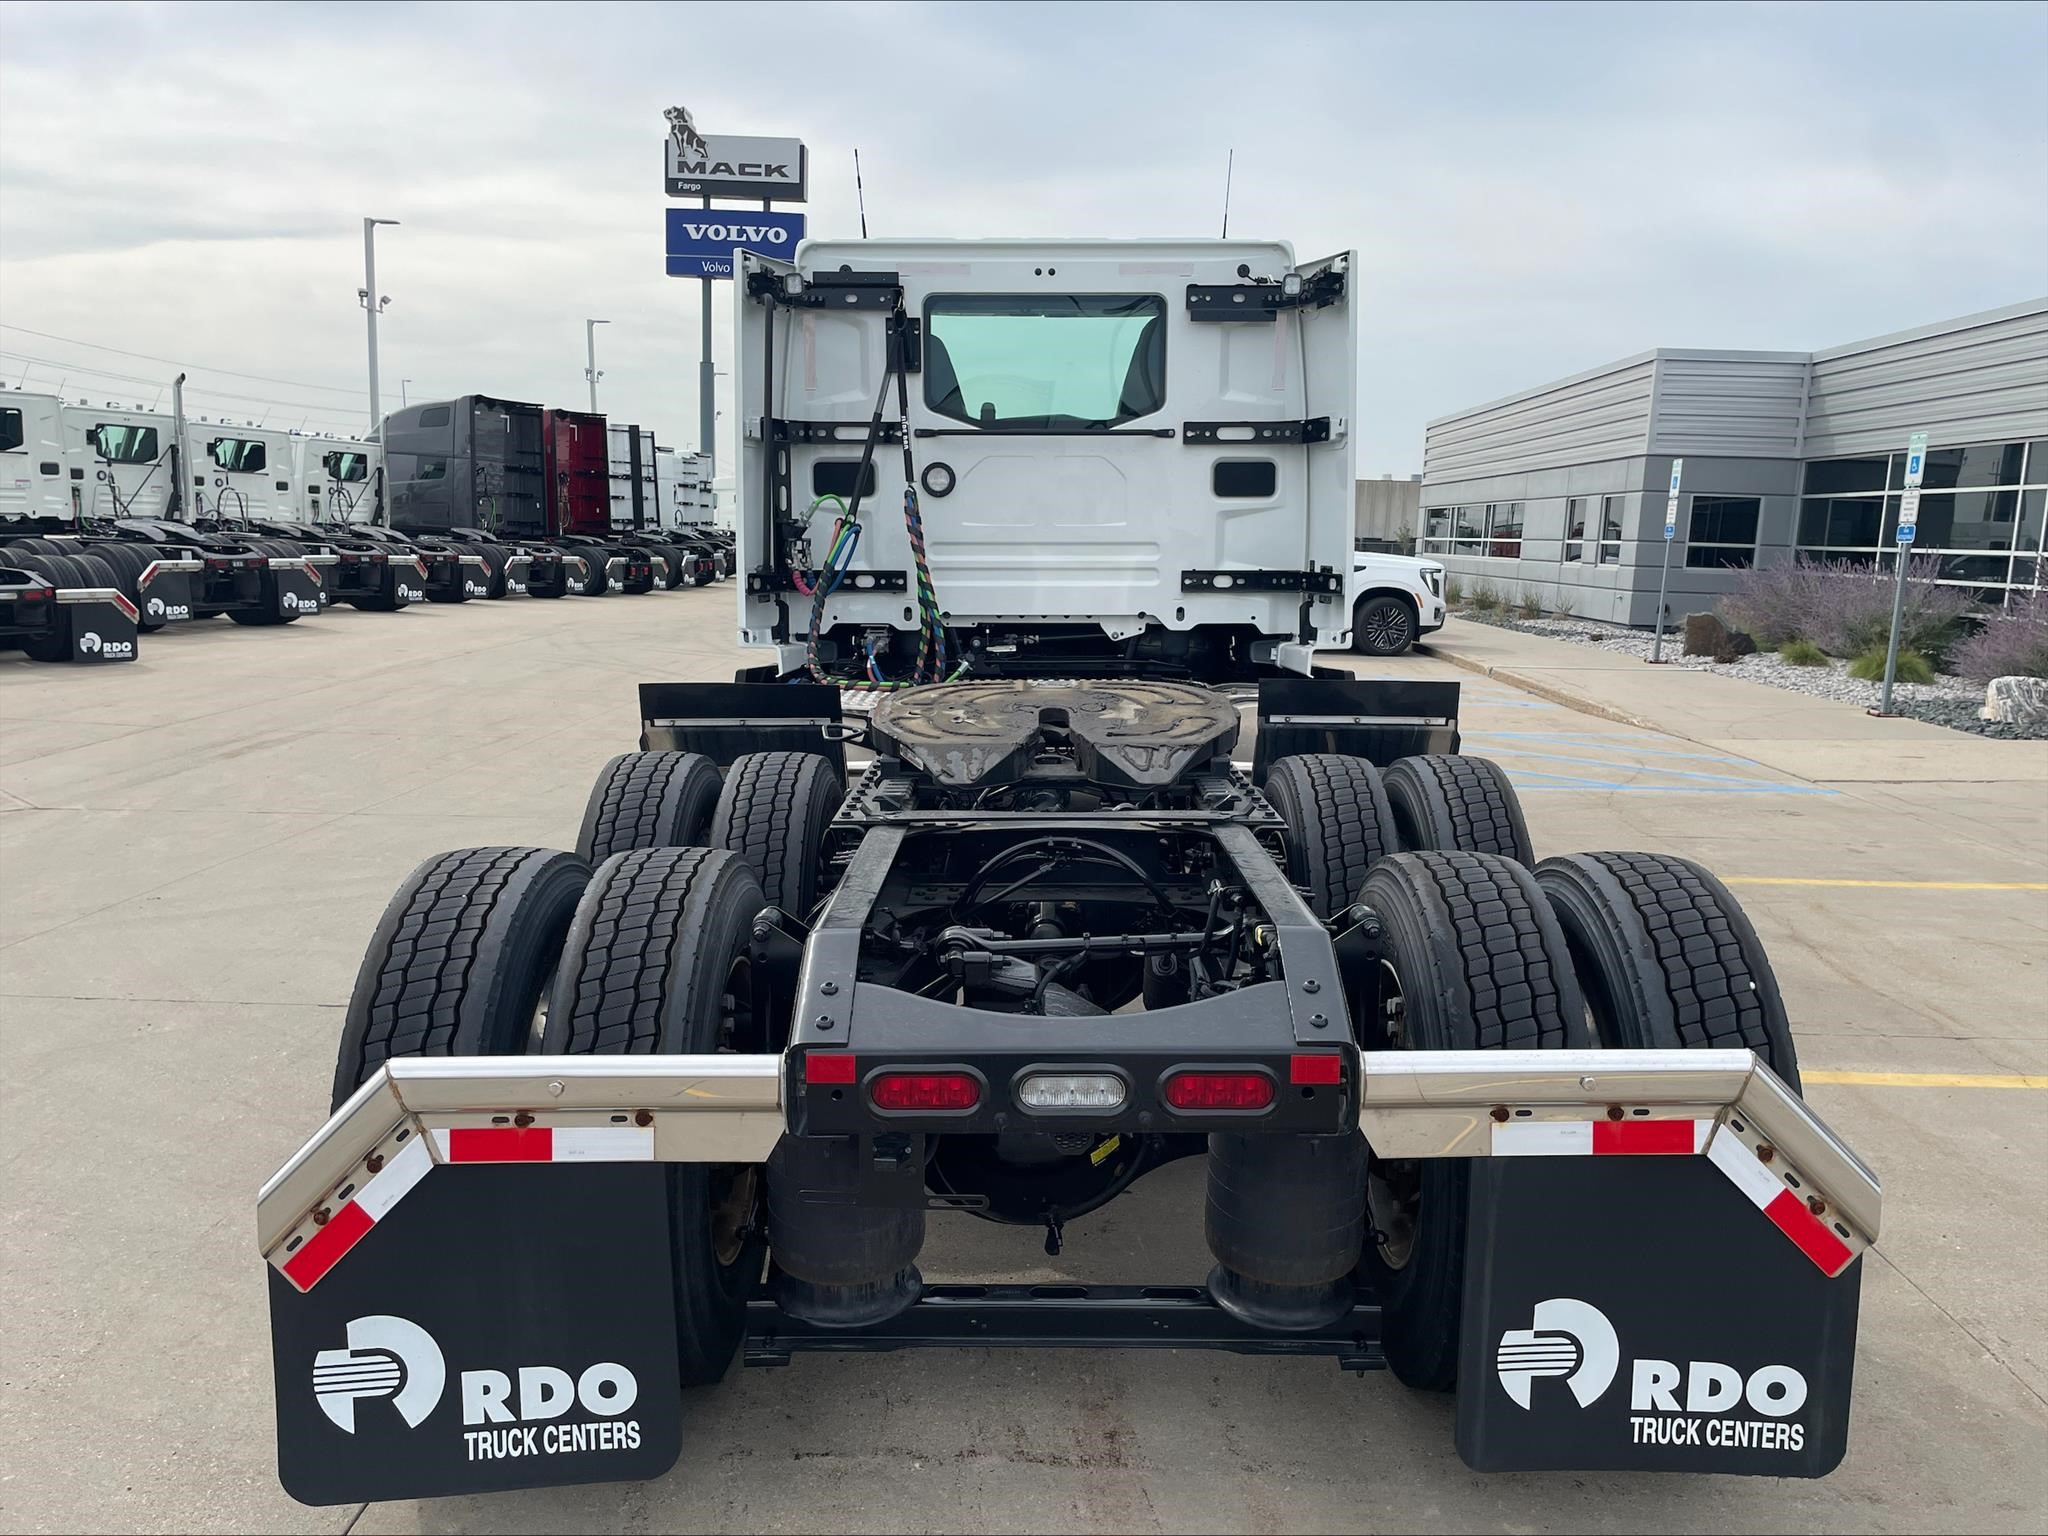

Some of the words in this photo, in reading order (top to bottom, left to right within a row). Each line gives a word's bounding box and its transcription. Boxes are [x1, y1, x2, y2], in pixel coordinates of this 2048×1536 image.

[677, 160, 789, 178] MACK
[677, 181, 701, 192] Fargo
[682, 223, 788, 244] VOLVO
[701, 260, 731, 273] Volvo
[166, 605, 188, 615] RDO
[298, 600, 317, 608] RDO
[103, 641, 132, 653] RDO
[461, 1362, 637, 1425] RDO
[1631, 1359, 1807, 1416] RDO
[464, 1427, 539, 1460] TRUCK
[544, 1421, 641, 1454] CENTERS
[1630, 1417, 1701, 1445] TRUCK
[1706, 1419, 1804, 1451] CENTERS
